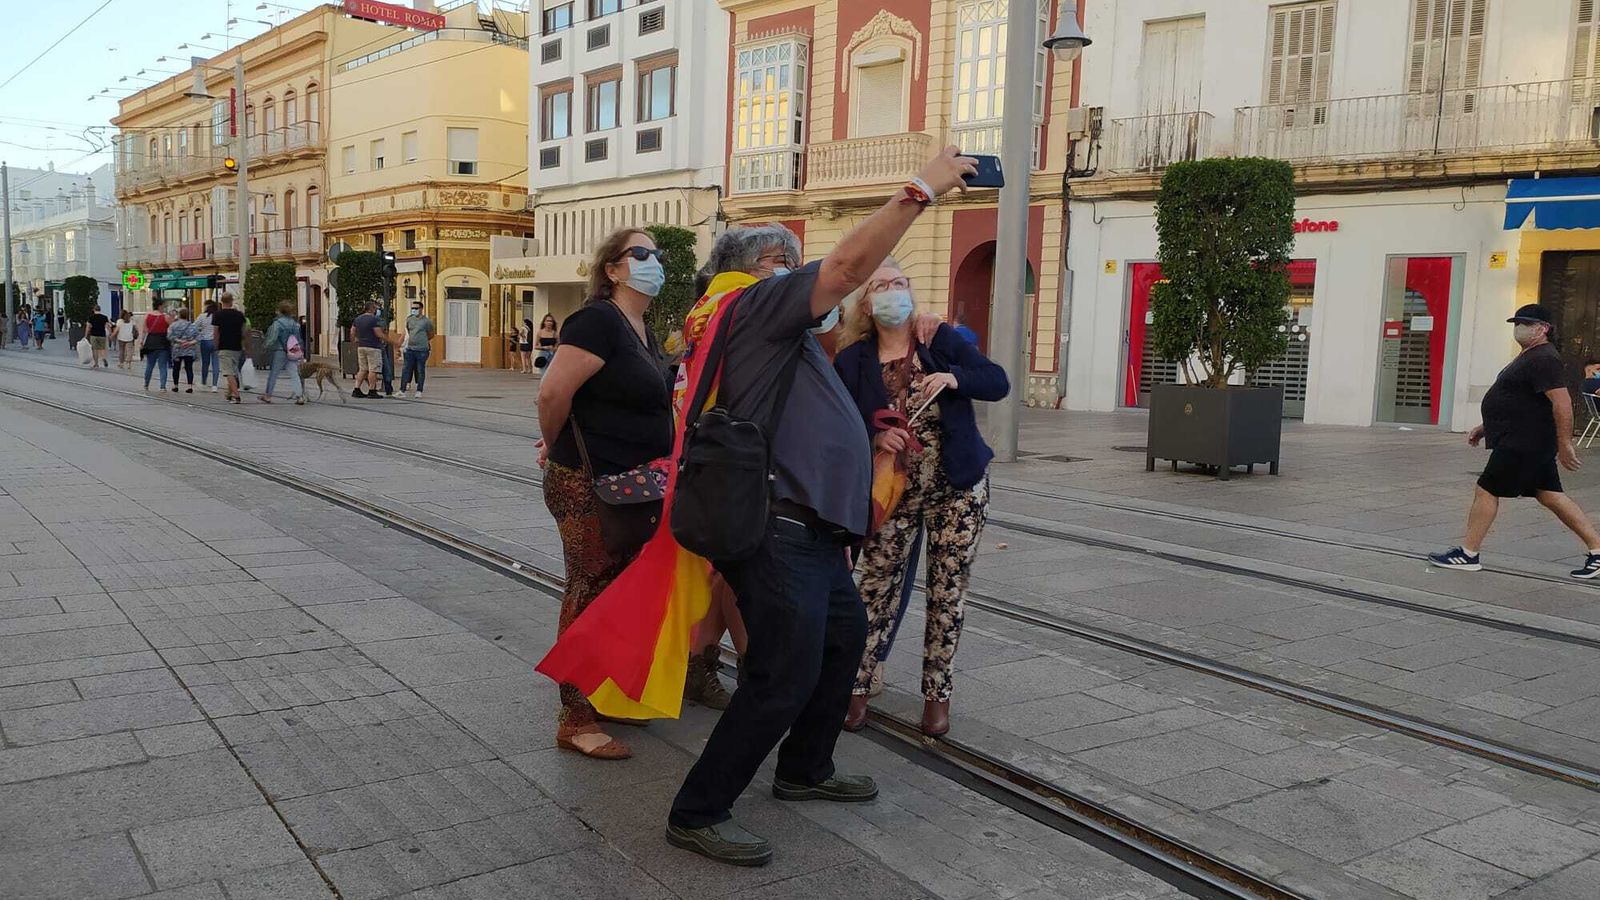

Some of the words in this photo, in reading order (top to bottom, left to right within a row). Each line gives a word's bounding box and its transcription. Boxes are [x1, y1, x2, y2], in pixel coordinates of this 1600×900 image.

[361, 3, 399, 20] HOTEL
[405, 12, 437, 27] ROMA
[1293, 218, 1339, 233] afone
